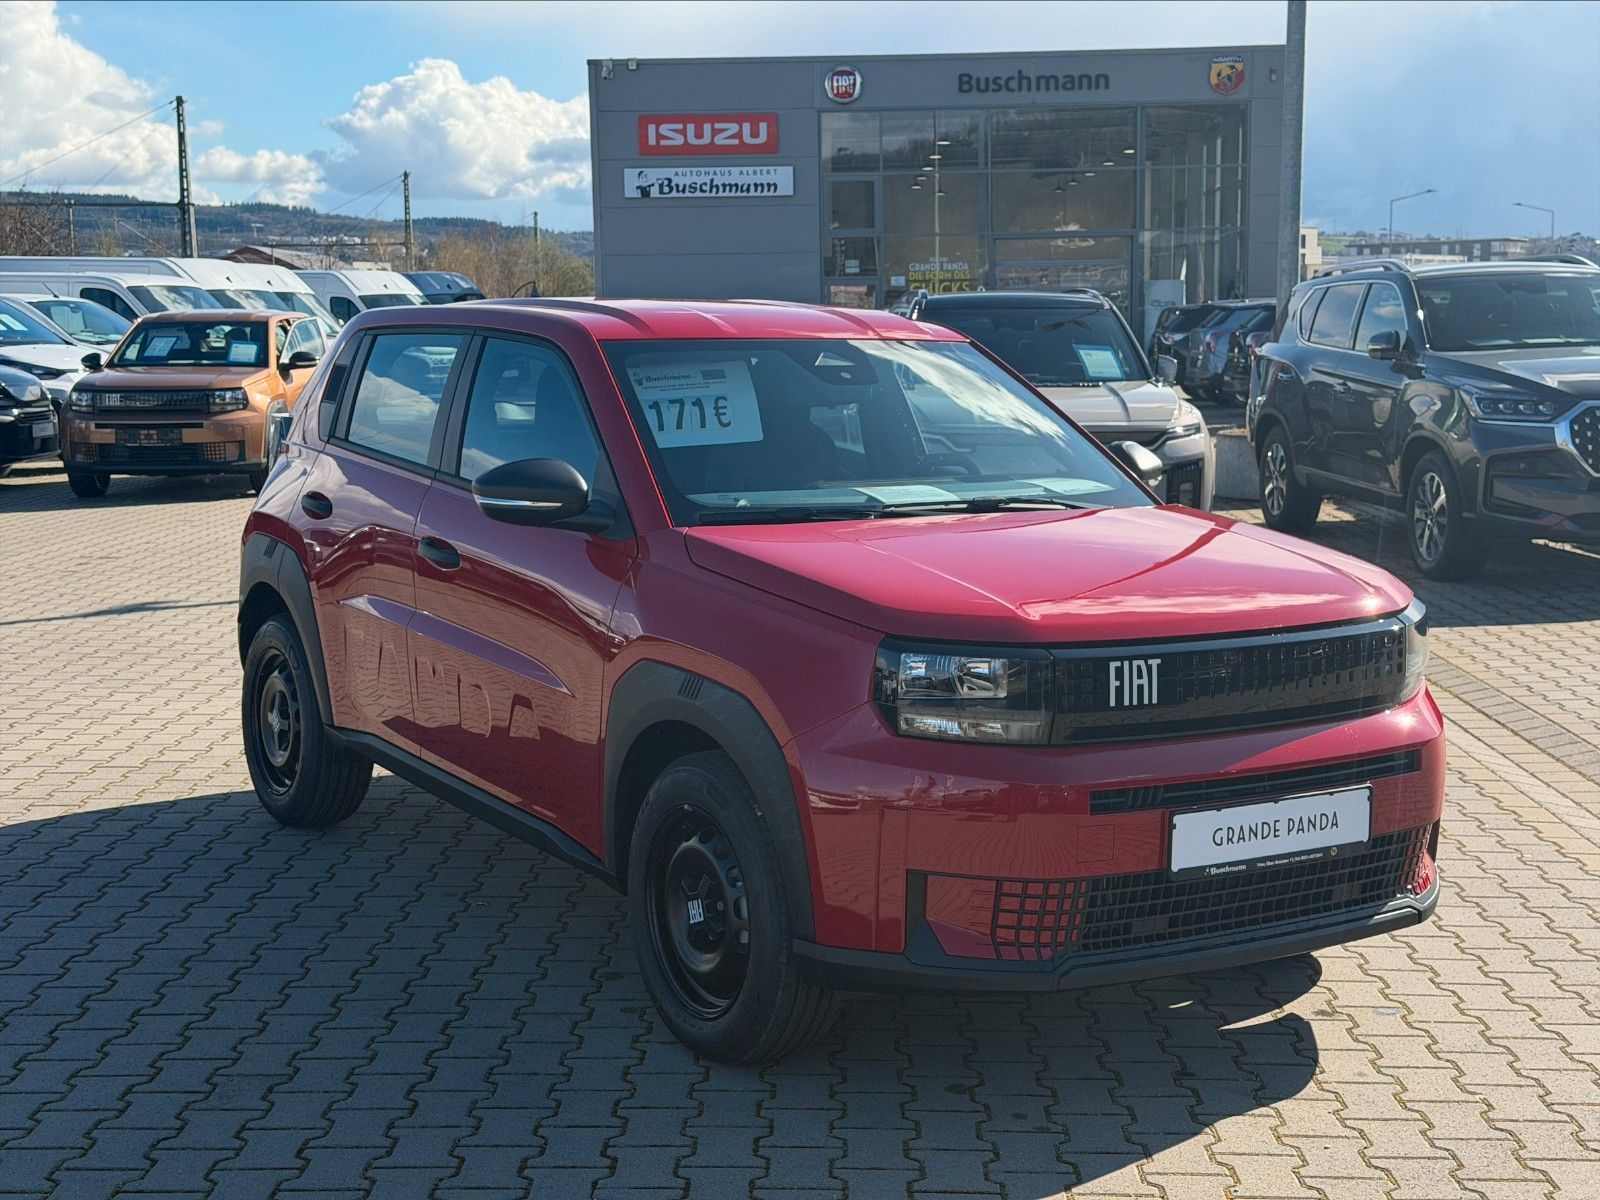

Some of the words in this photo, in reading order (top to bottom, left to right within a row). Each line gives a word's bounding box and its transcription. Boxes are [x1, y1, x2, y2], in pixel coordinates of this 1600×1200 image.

[957, 69, 1110, 93] Buschmann
[647, 121, 768, 146] ISUZU
[673, 169, 732, 177] AUTOHAUS
[738, 168, 778, 176] ALBERT
[656, 177, 778, 195] Buschmann
[909, 263, 940, 271] GRANDE
[1109, 658, 1162, 708] FIAT
[1211, 819, 1281, 847] GRANDE
[1286, 810, 1339, 836] PANDA
